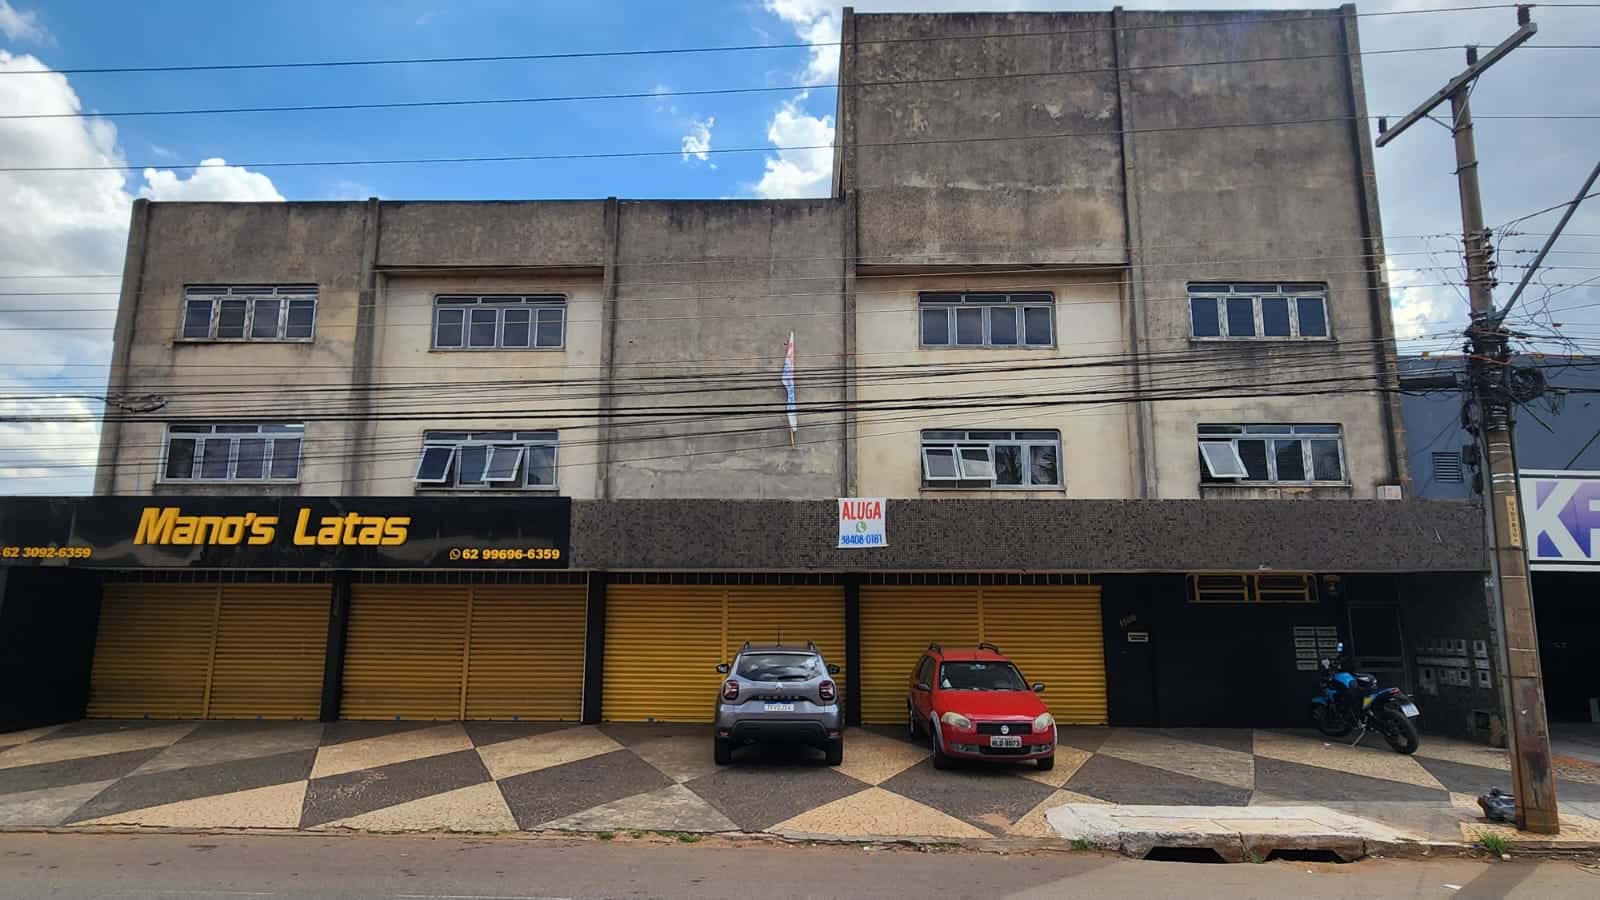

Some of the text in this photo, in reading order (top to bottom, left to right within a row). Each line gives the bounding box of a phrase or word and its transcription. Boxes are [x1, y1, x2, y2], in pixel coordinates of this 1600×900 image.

[842, 501, 882, 520] ALUGA
[133, 507, 411, 546] Mano's Latas
[2, 547, 92, 558] 62 3092-6359
[462, 549, 560, 560] 62 99696-6359
